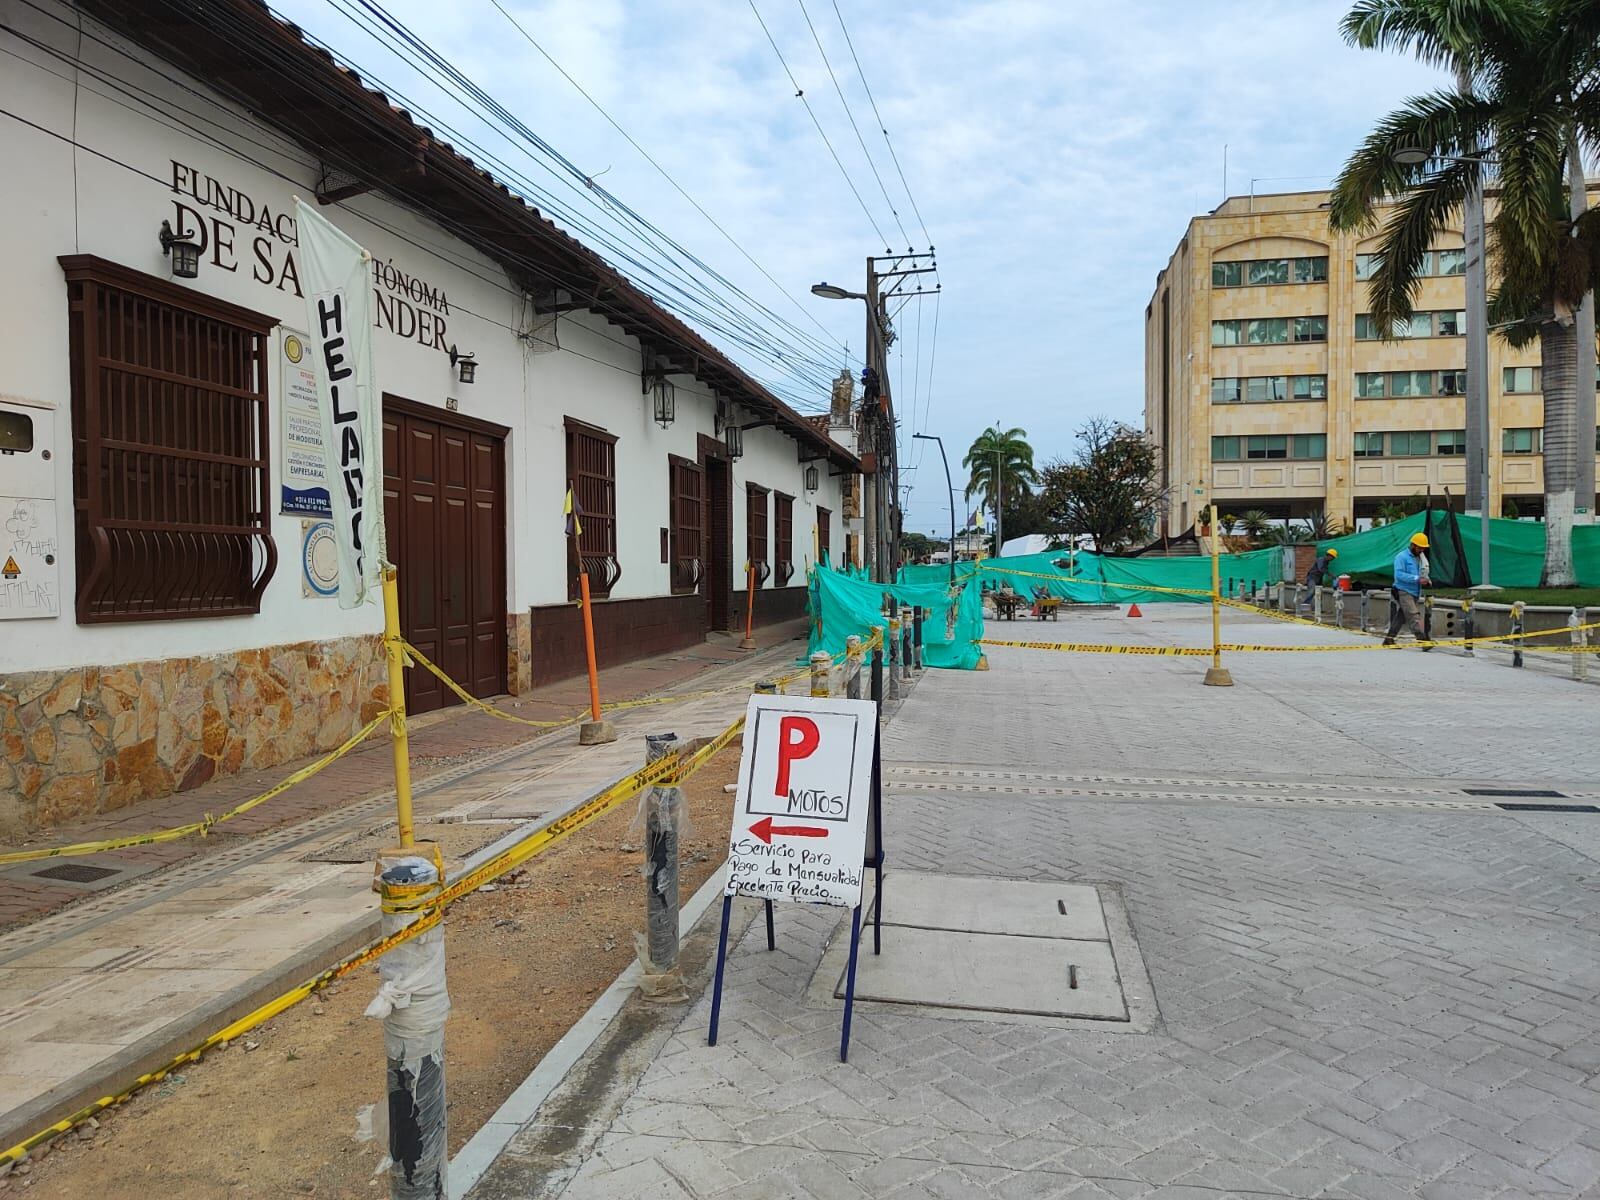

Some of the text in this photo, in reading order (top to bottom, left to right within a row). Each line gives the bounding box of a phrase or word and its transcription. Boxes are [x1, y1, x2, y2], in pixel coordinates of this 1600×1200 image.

[170, 199, 239, 273] DE
[775, 716, 820, 797] P
[787, 788, 844, 815] MOTOS
[728, 855, 860, 887] Pago de Mensualidad
